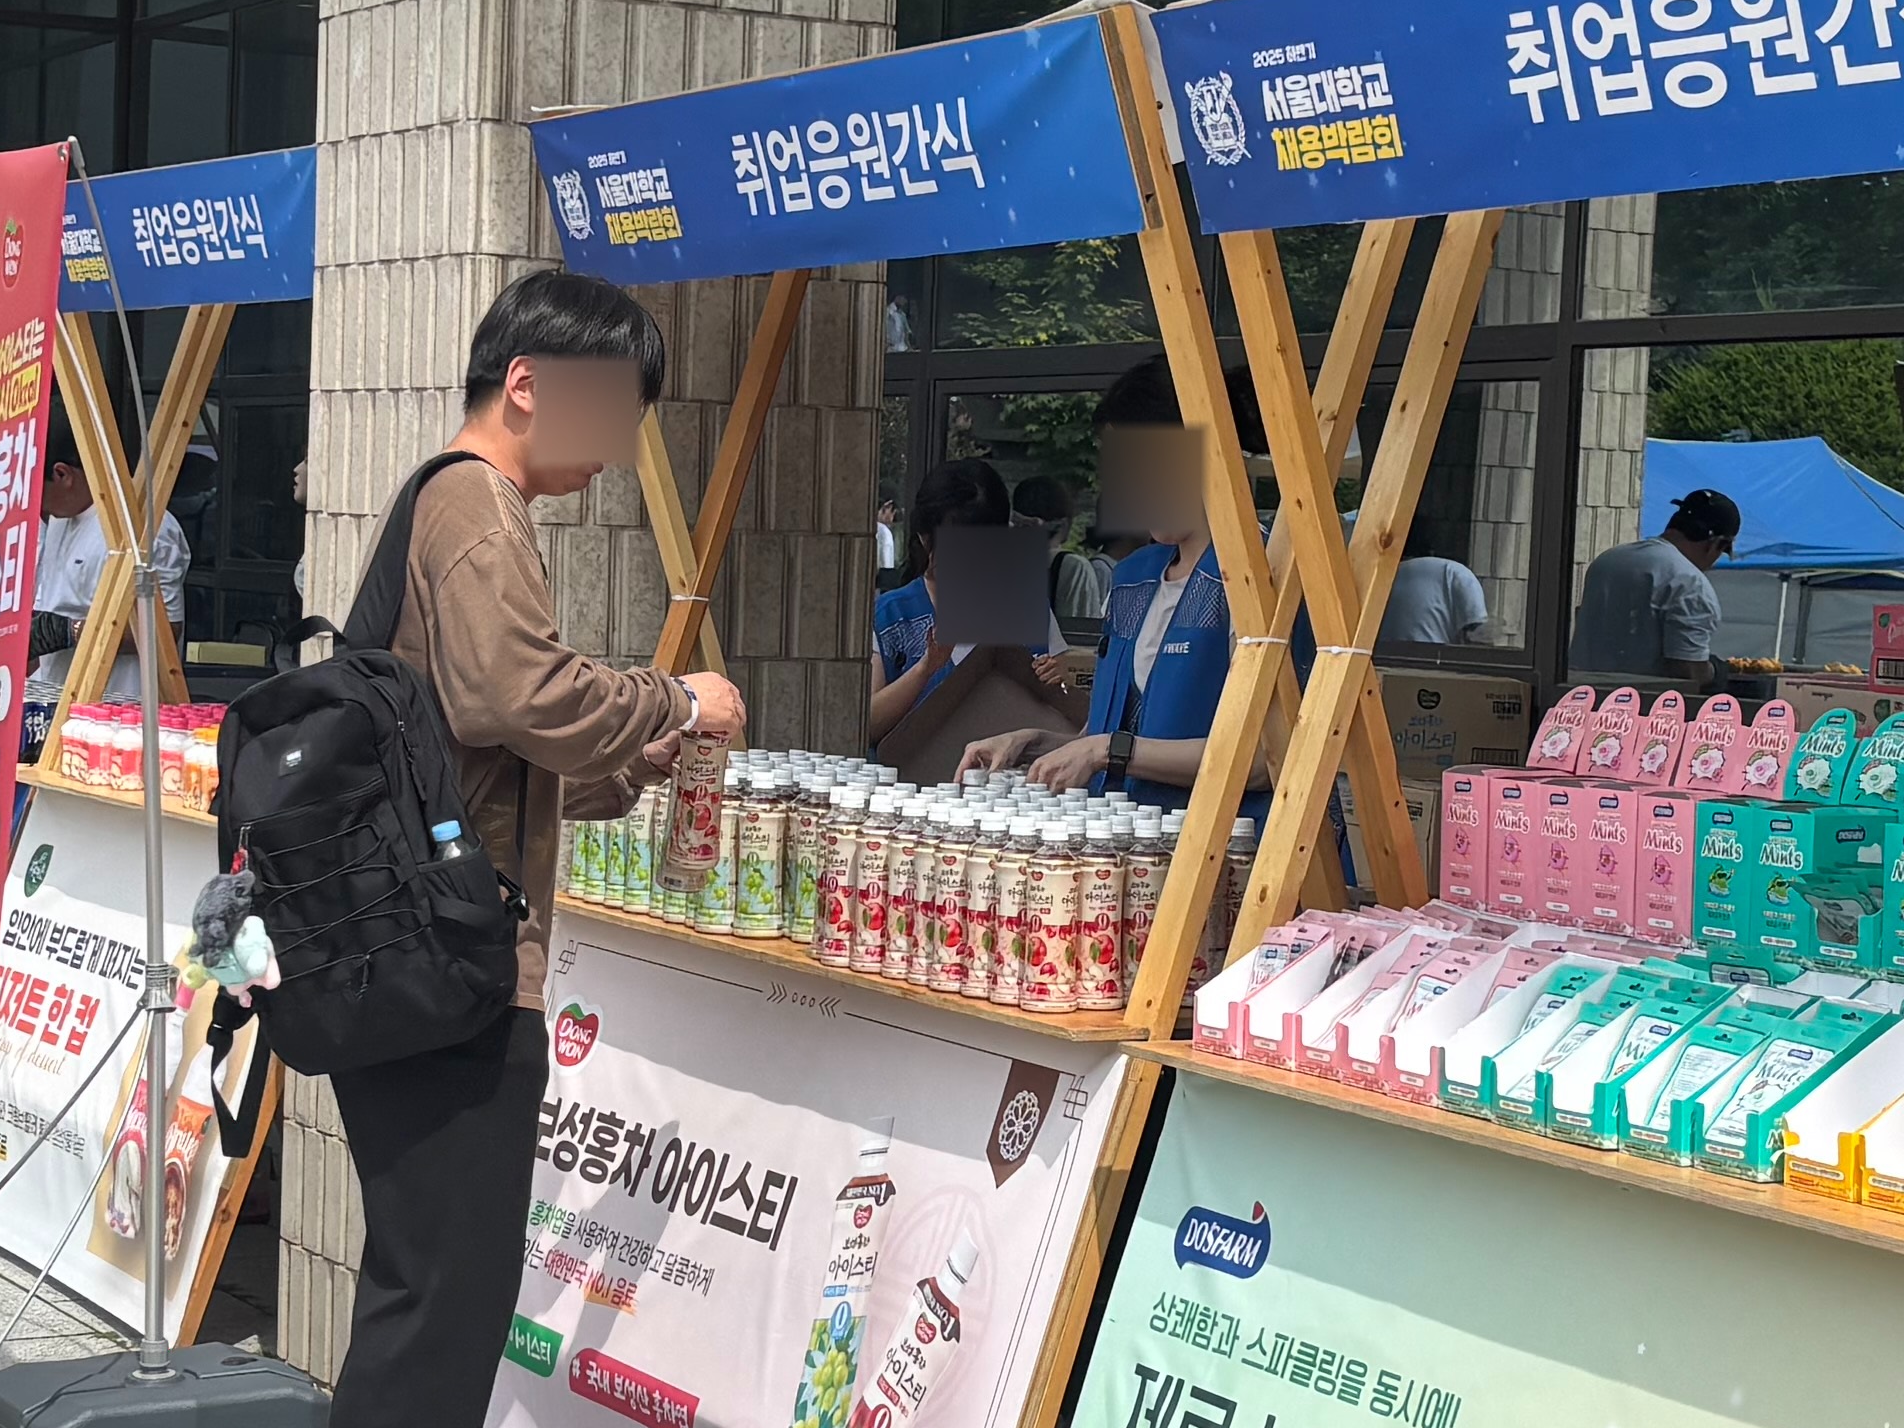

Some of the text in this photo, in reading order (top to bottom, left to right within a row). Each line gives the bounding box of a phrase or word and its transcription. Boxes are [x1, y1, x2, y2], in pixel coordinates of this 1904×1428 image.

[1253, 48, 1284, 68] 2025
[1262, 63, 1394, 122] 서울대학교
[731, 96, 986, 218] 취업응원간식
[1271, 114, 1403, 171] 채용박람회
[596, 167, 673, 208] 서울대학교
[132, 194, 269, 267] 취업응원간식
[605, 205, 683, 245] 채용박람회
[1746, 728, 1789, 753] Mints
[1541, 815, 1577, 841] Mints
[1643, 828, 1683, 855] Mints
[40, 983, 101, 1056] 한 컵
[558, 1017, 593, 1045] DONG
[557, 1038, 585, 1060] WON
[651, 1136, 799, 1252] 아이스티
[544, 1248, 588, 1289] 대한민국
[574, 1218, 716, 1297] 사용하여 건강하고 달콤하게
[828, 1251, 878, 1281] 아이스티
[1149, 1291, 1241, 1359] 상쾌함과
[1241, 1327, 1369, 1406] 스파클링을
[586, 1360, 610, 1395] 국내
[613, 1372, 650, 1415] 보성산
[886, 1348, 927, 1411] 아이스티
